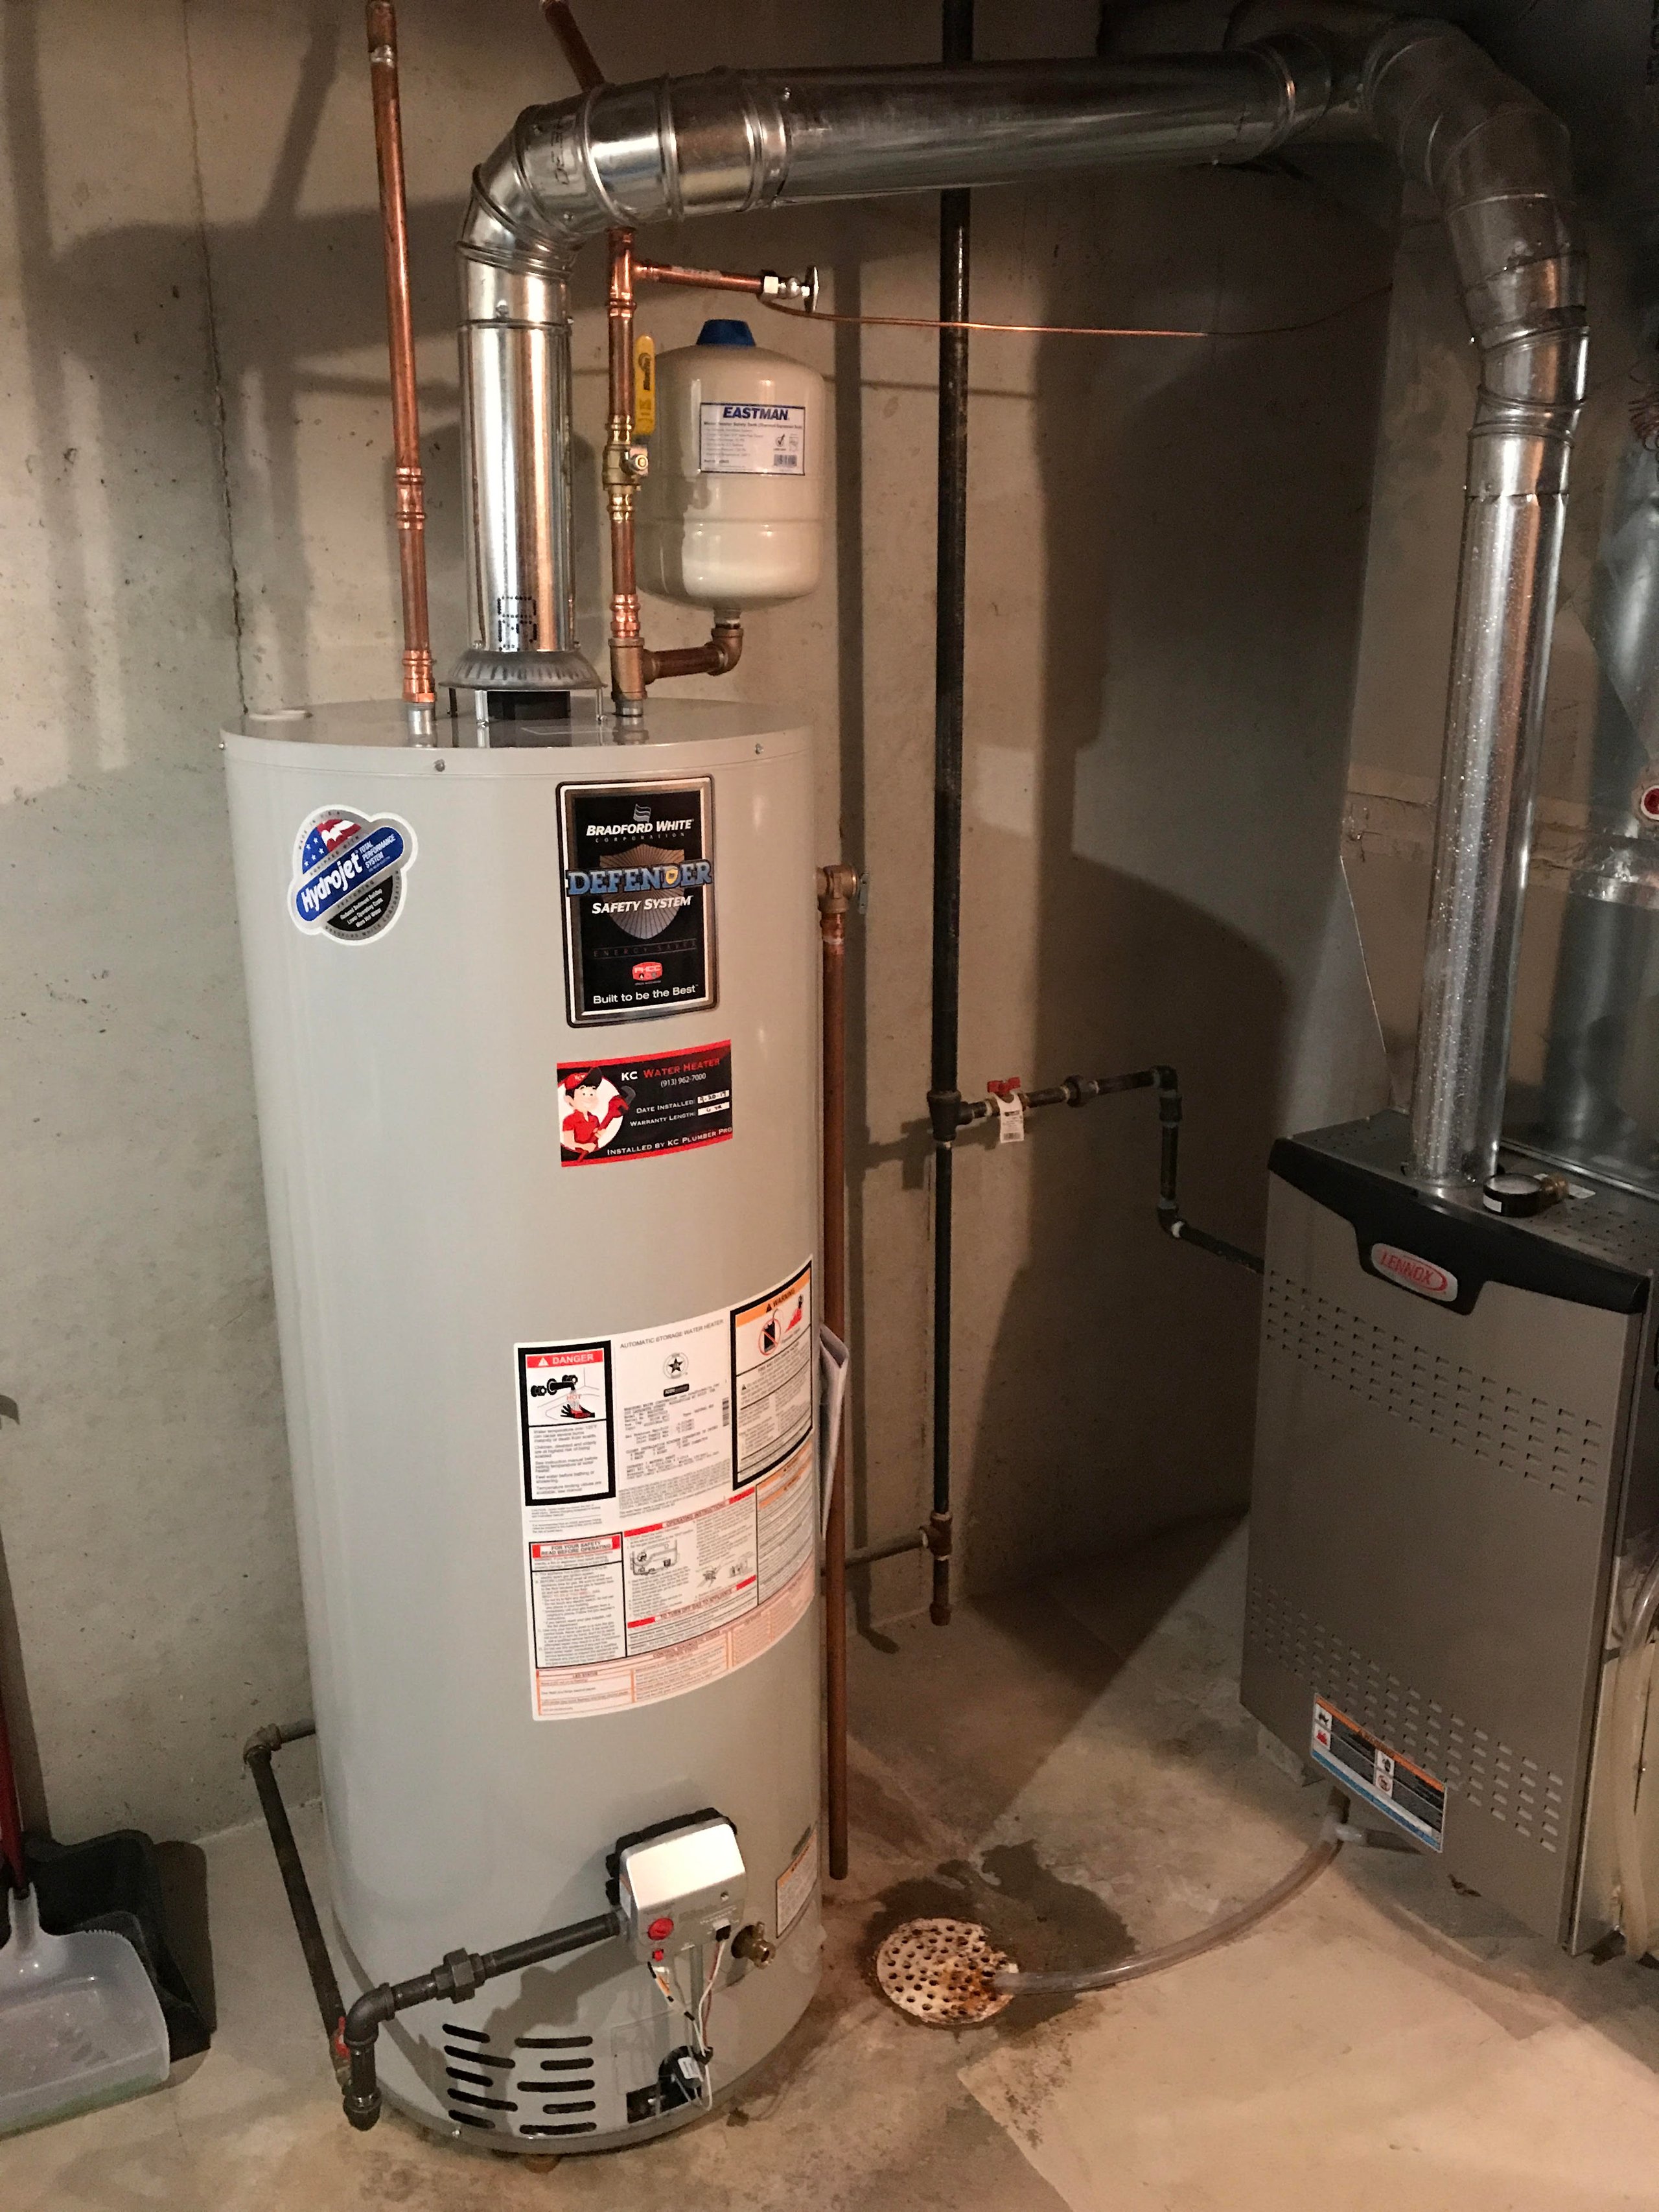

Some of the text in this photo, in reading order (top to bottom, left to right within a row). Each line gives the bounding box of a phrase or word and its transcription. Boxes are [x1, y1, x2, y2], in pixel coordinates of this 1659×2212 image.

[723, 406, 789, 421] EASTMAN
[586, 819, 692, 836] BRADFORD WHITE
[594, 832, 685, 843] CORPORATION
[358, 840, 374, 854] TOTAL
[362, 833, 397, 862] PERFORMANCE
[365, 851, 385, 869] SYSTEM
[301, 852, 363, 913] Hydrojet
[568, 861, 712, 895] DEFENDER
[592, 896, 692, 914] SAFETY SYSTEM
[593, 947, 648, 957] ENERGY
[634, 964, 661, 973] PHCC
[593, 984, 695, 1004] Built to be the Best
[621, 1058, 720, 1082] KC WATER HEATER
[660, 1073, 706, 1089] (913) 962-7000
[636, 1099, 696, 1114] DATE INSTALLED:
[630, 1112, 696, 1127] WARRANTY LENGTH:
[607, 1143, 653, 1156] INSTALLED
[667, 1138, 679, 1147] KC
[682, 1130, 717, 1144] PLUMBER
[1379, 1252, 1434, 1285] LENNOX
[620, 1318, 724, 1349] AUTOMATIC STORAGE WATER HEATER
[552, 1353, 594, 1365] DANGER
